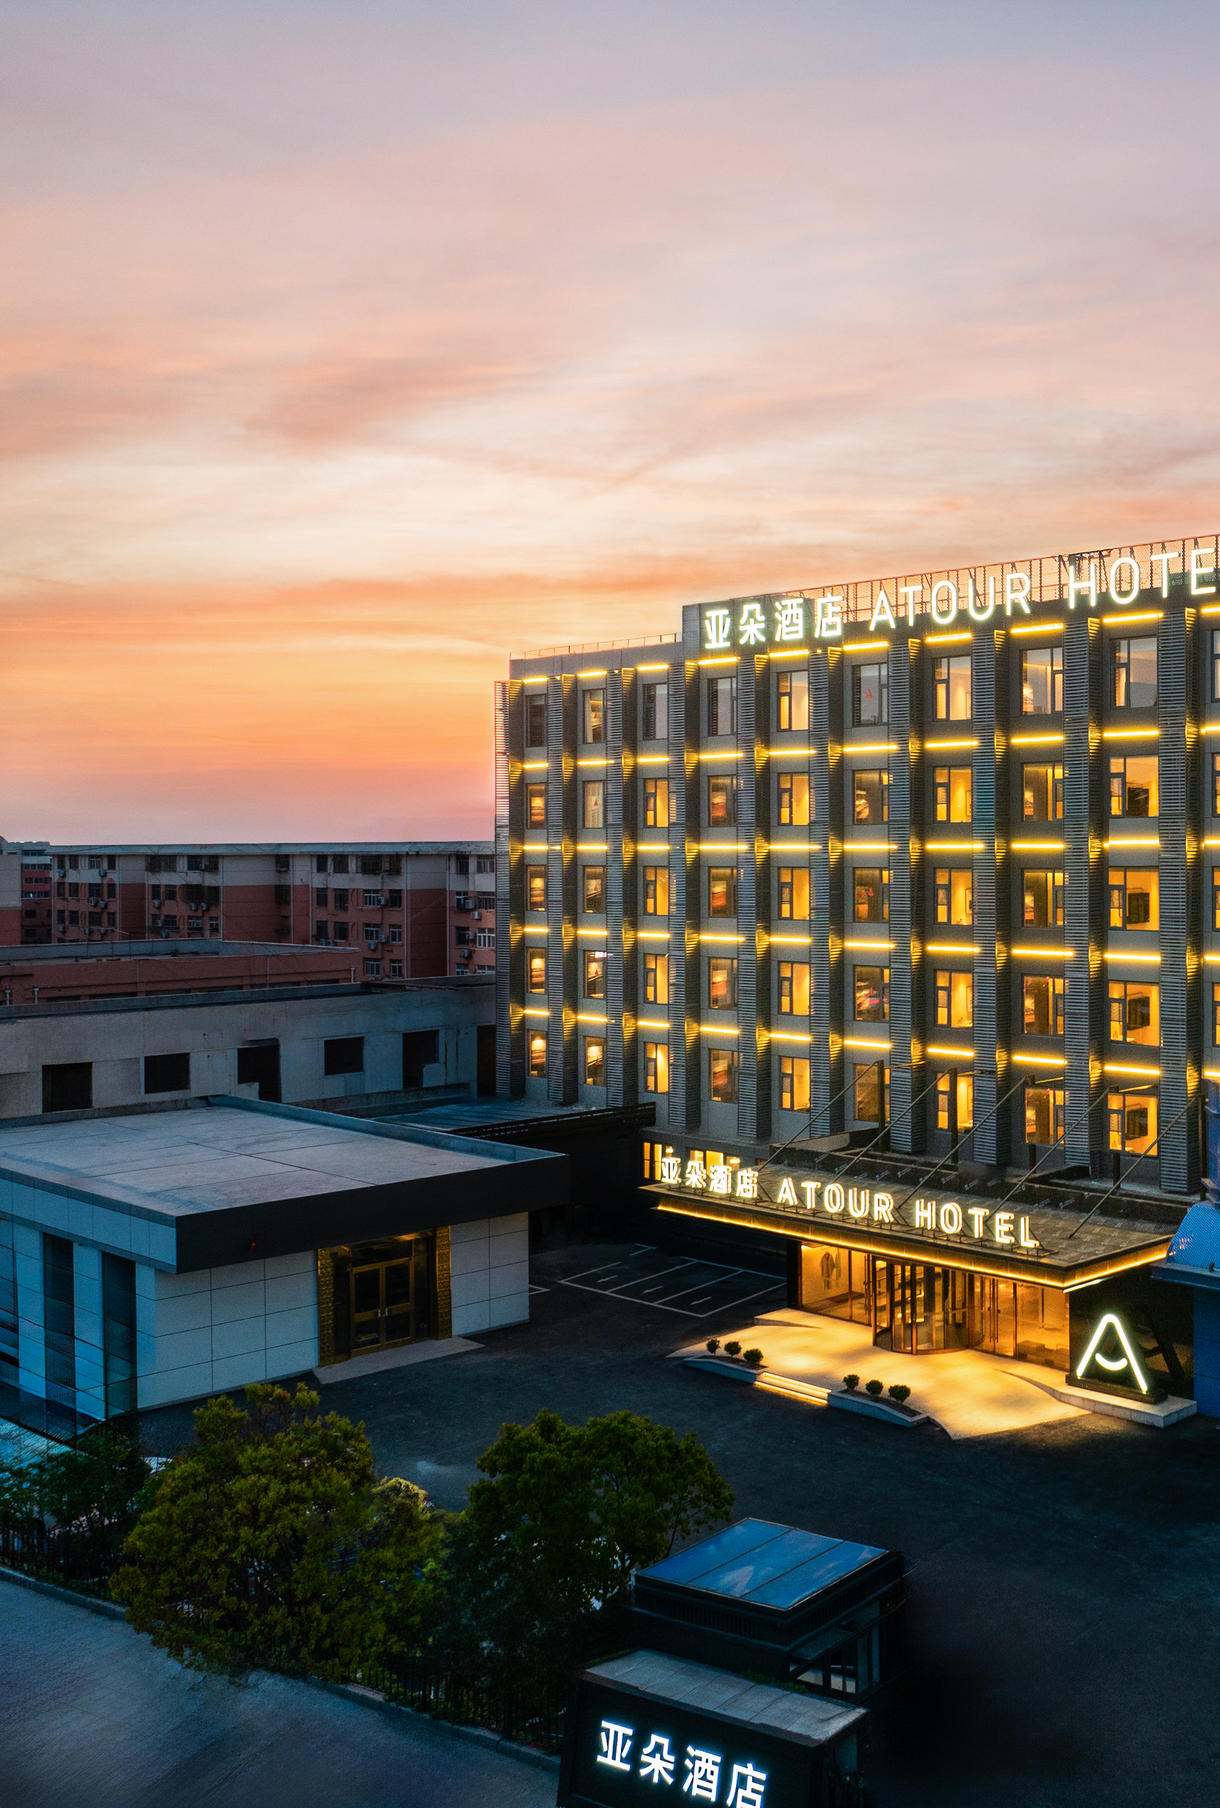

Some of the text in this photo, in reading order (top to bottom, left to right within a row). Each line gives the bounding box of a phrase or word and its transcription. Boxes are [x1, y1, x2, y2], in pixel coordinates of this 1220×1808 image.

[703, 594, 845, 650] 亚朵酒店
[868, 571, 1032, 631] ATOUR
[660, 1156, 1041, 1249] 亚朵酒店 ATOUR HOTEL
[596, 1719, 768, 1808] 亚朵酒店
